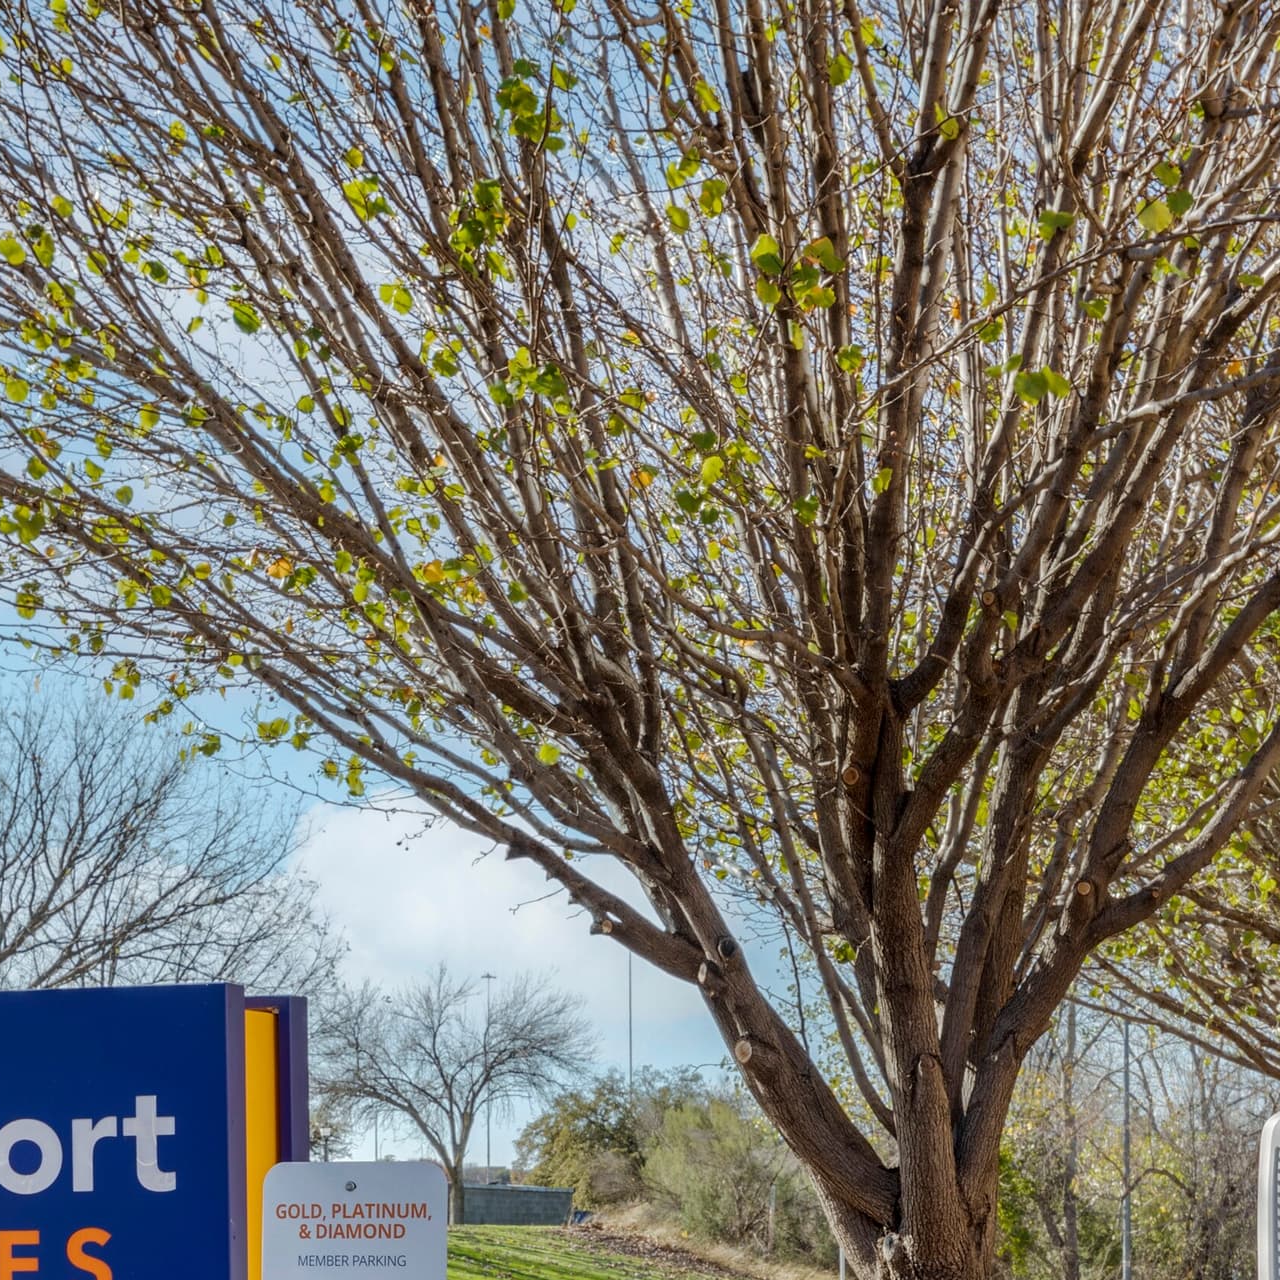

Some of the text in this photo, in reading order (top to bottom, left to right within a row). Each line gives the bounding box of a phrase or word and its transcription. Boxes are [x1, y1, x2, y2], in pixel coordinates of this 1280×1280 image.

[276, 1202, 433, 1221] GOLD, PLATINUM,
[299, 1223, 406, 1239] & DIAMOND
[297, 1255, 407, 1267] MEMBER PARKING
